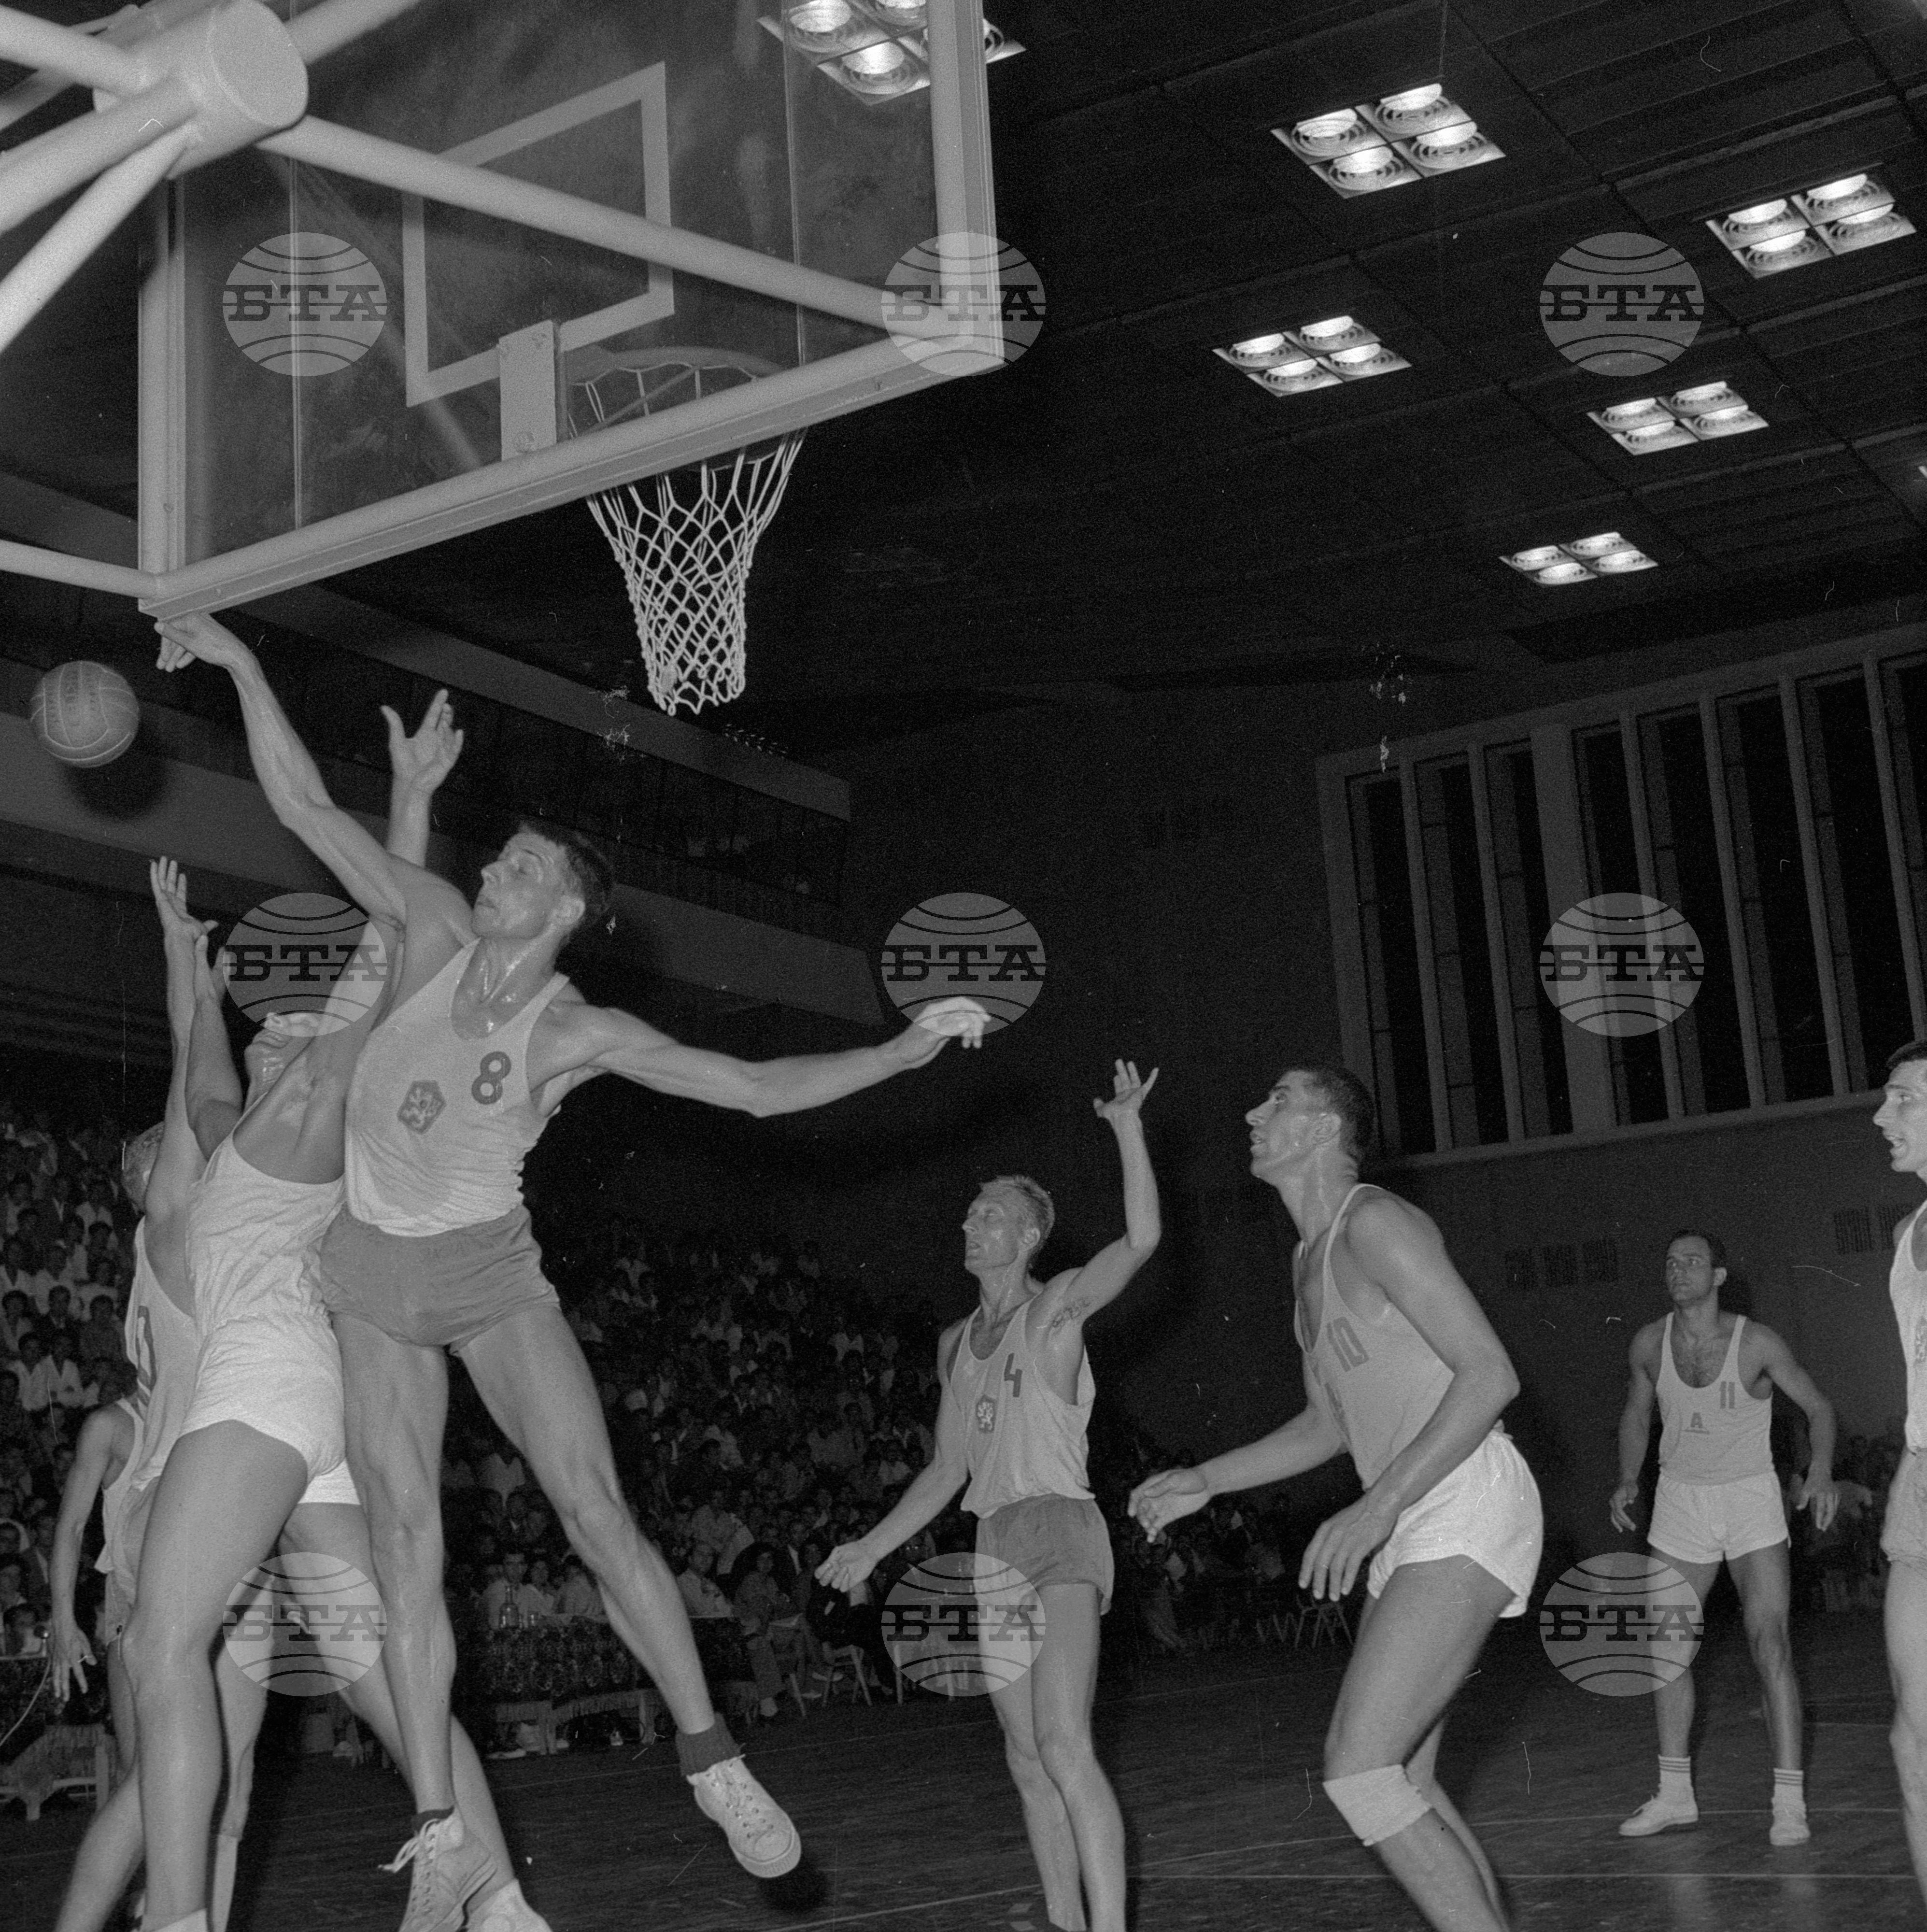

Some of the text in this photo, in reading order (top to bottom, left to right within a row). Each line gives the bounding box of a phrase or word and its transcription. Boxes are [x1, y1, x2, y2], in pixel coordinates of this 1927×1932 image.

[471, 1051, 511, 1105] 8
[1327, 1316, 1369, 1373] 10
[1004, 1352, 1023, 1397] 4
[1719, 1380, 1735, 1409] 11
